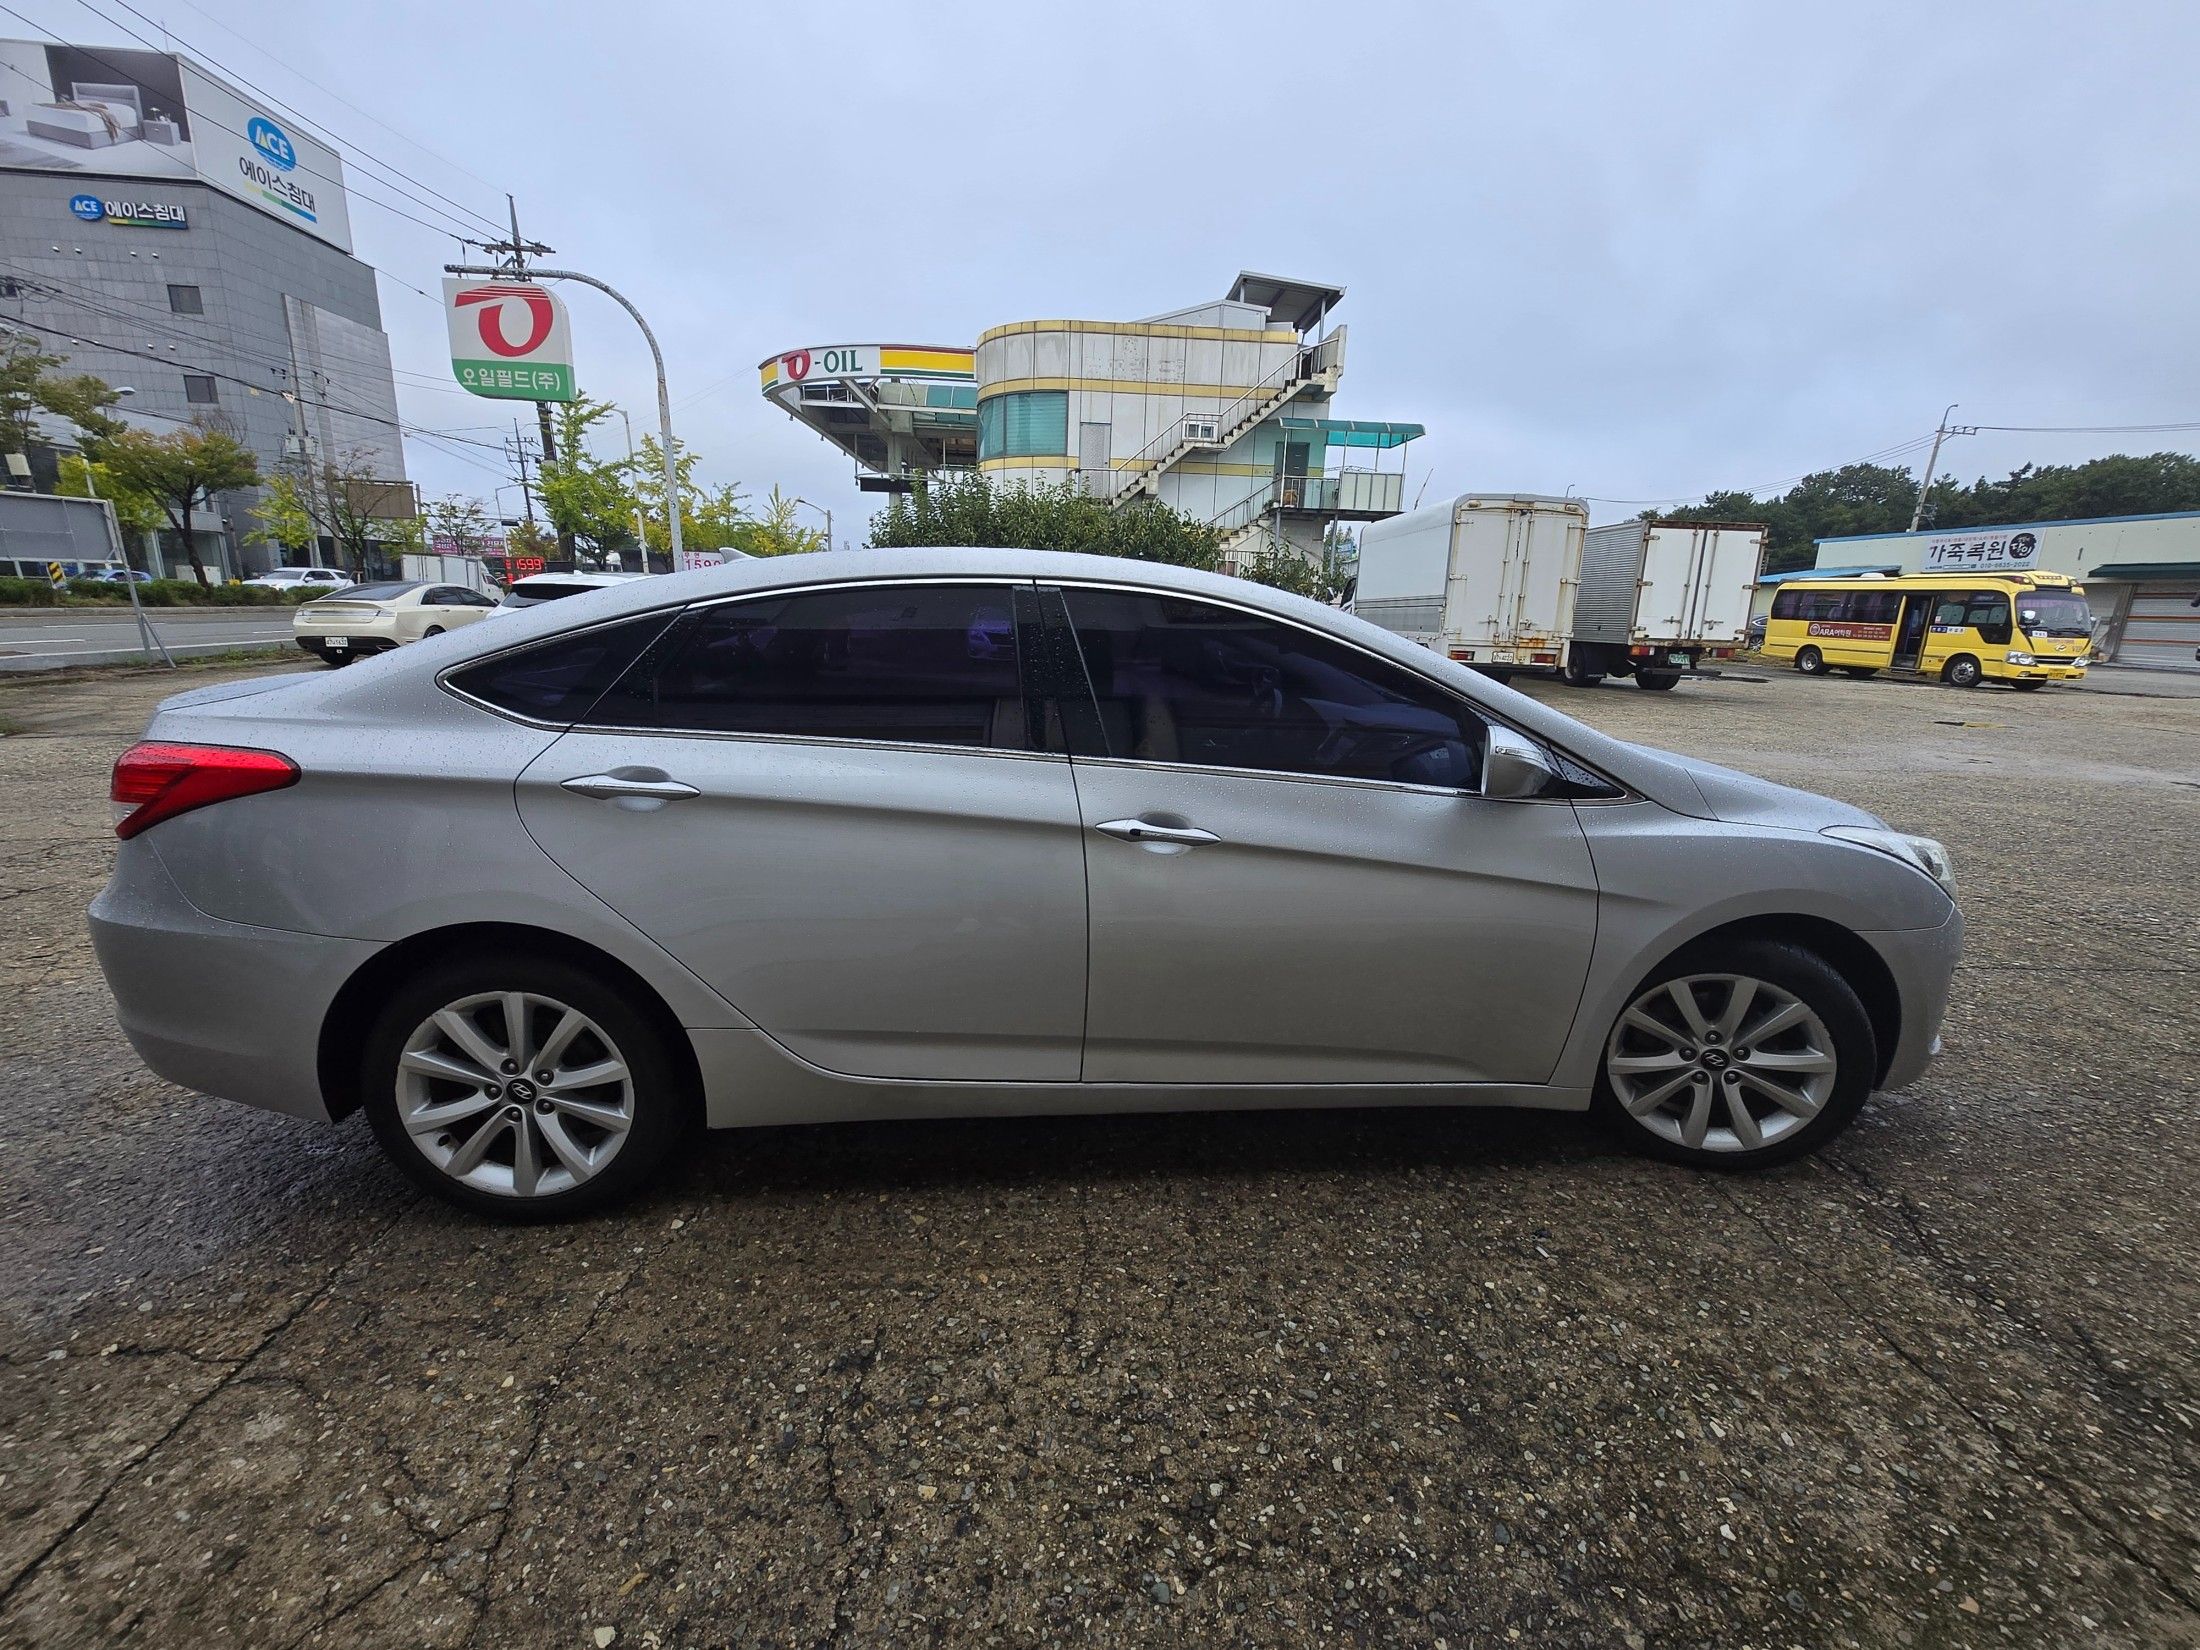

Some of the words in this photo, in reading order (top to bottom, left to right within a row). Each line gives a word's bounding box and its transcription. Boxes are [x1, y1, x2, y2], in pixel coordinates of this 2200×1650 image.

[255, 125, 290, 160] ACE
[239, 156, 316, 213] 에이스침대
[74, 200, 98, 212] ACE
[104, 201, 186, 221] 에이스침대
[461, 367, 561, 392] 오일필드(주)
[1930, 541, 2007, 563] 가죽복원
[516, 558, 542, 570] 1599
